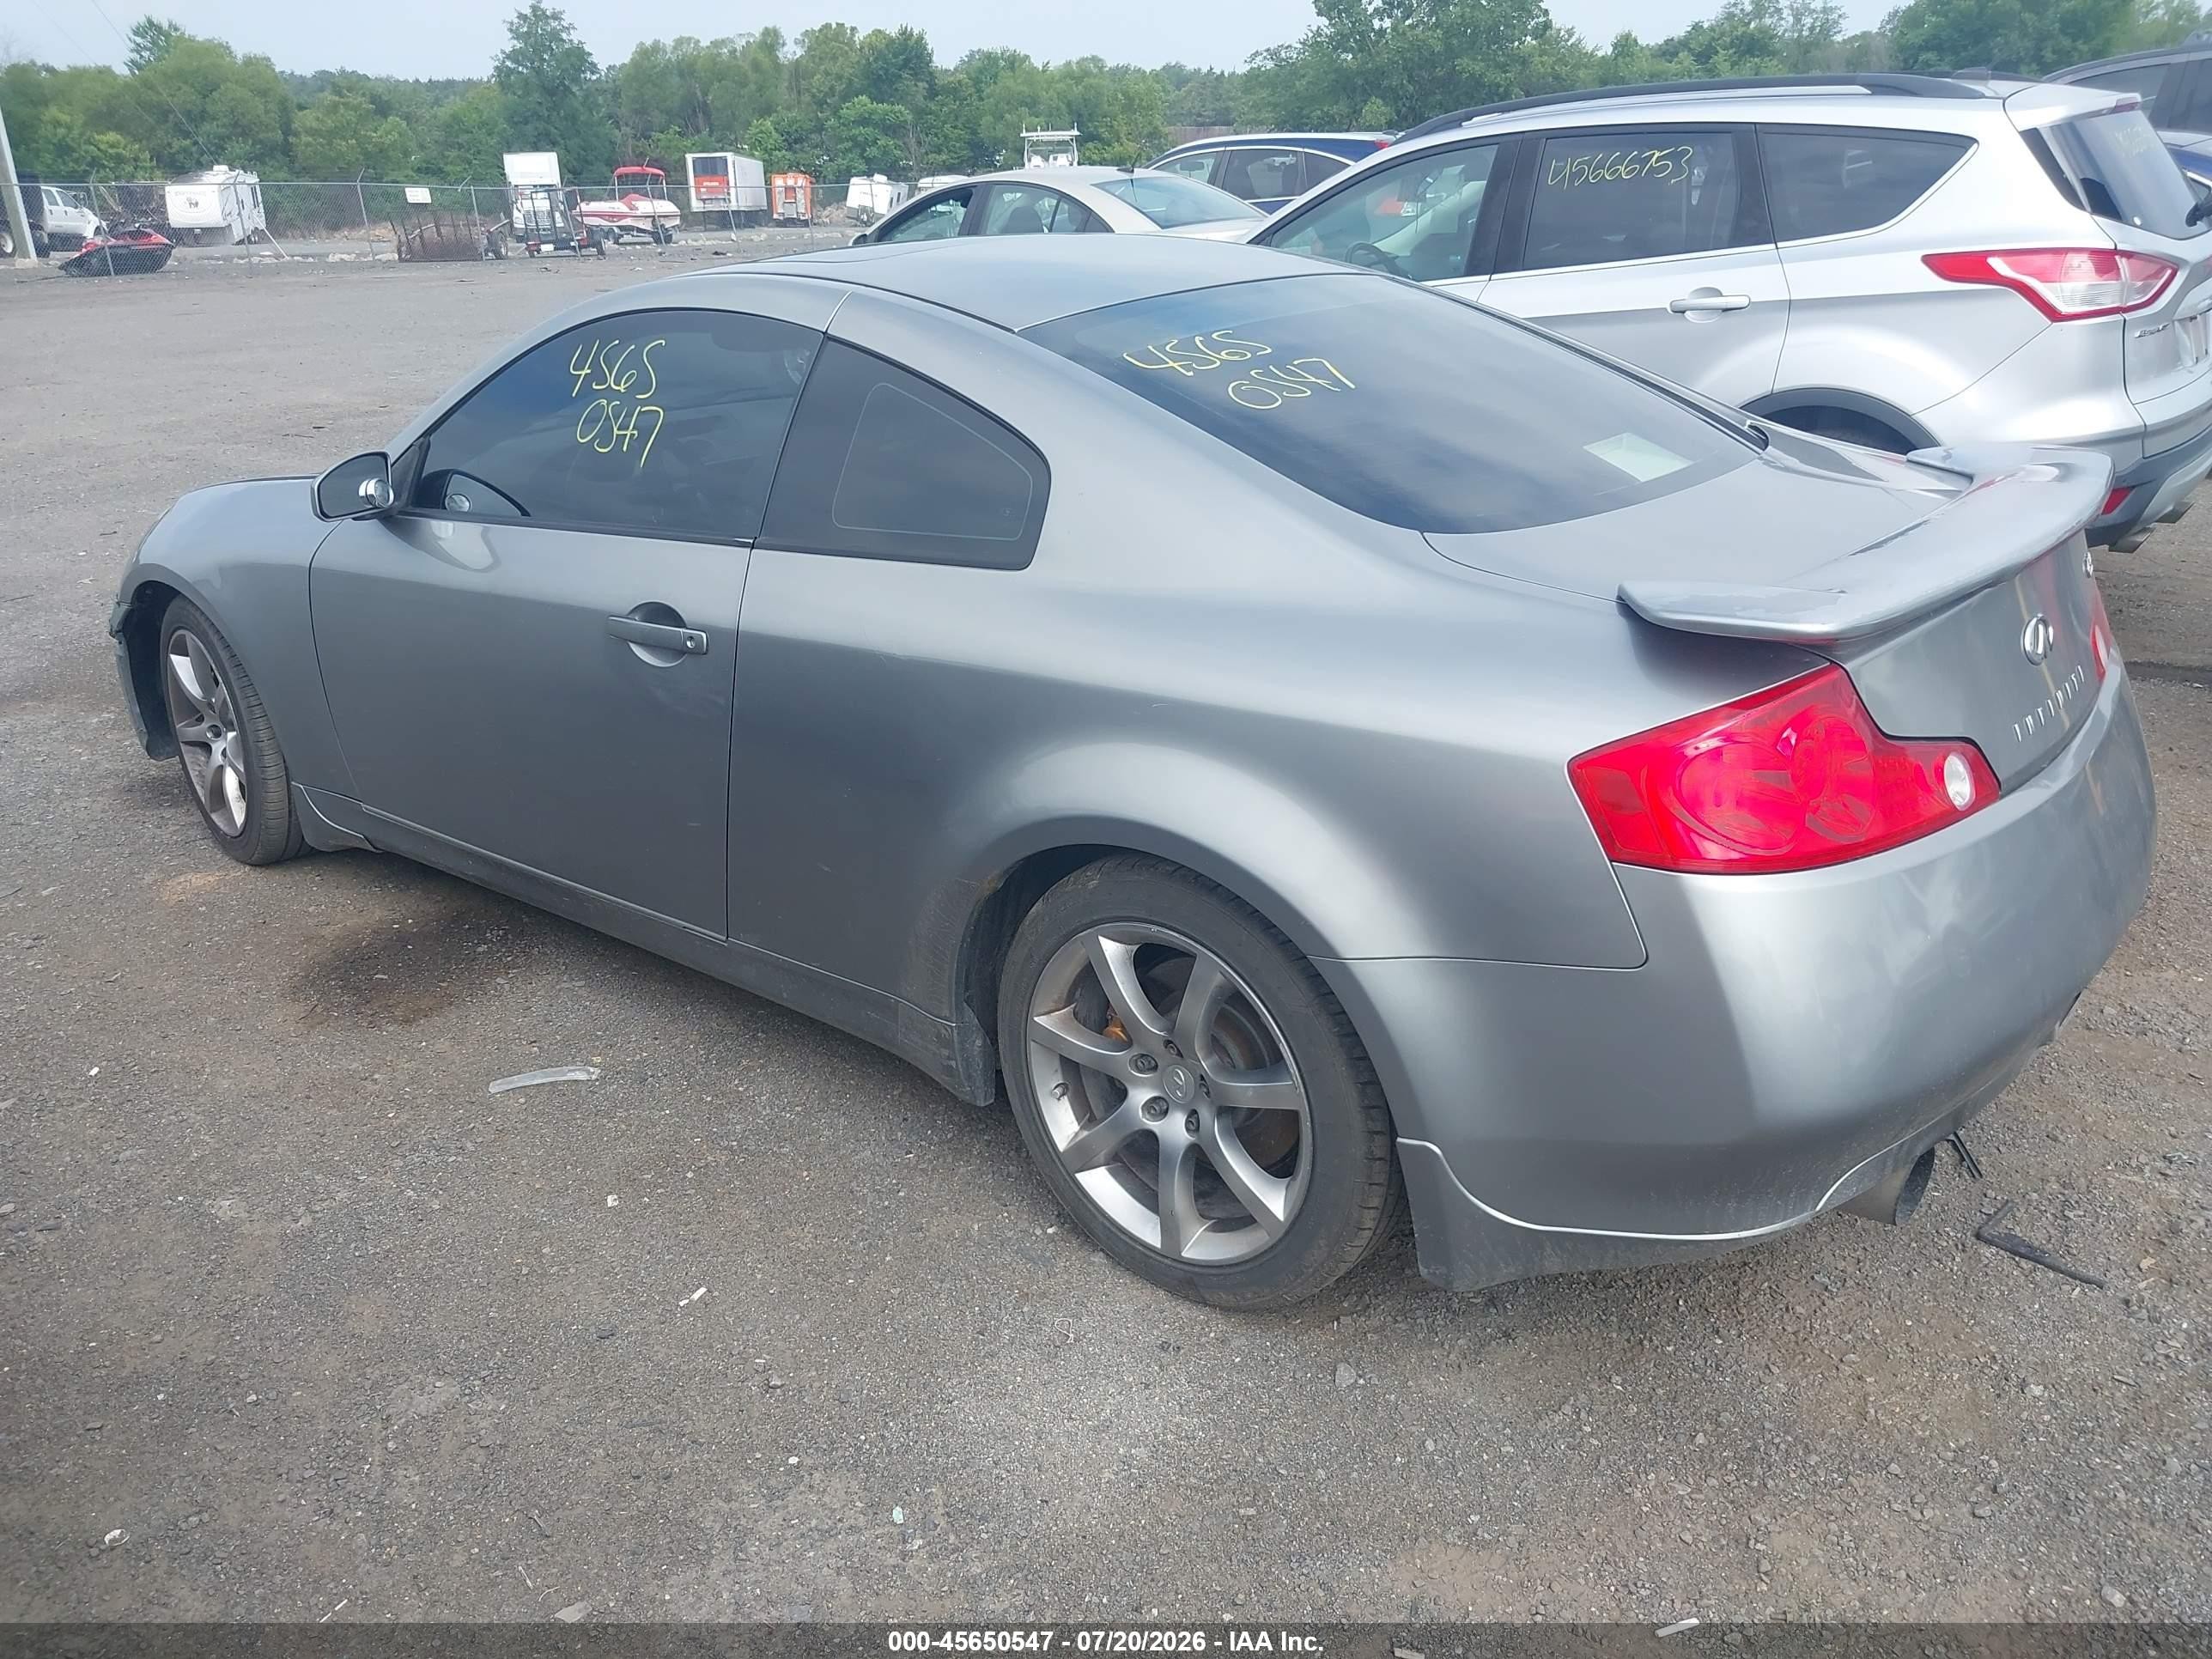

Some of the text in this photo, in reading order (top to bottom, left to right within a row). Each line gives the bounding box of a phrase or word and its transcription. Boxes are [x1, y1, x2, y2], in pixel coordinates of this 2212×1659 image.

[1547, 146, 1693, 190] 45666753
[569, 338, 666, 399] 4565
[1122, 330, 1273, 376] 4565
[1227, 357, 1356, 410] 0547
[576, 398, 665, 468] 0547
[2012, 664, 2086, 743] INFINITI
